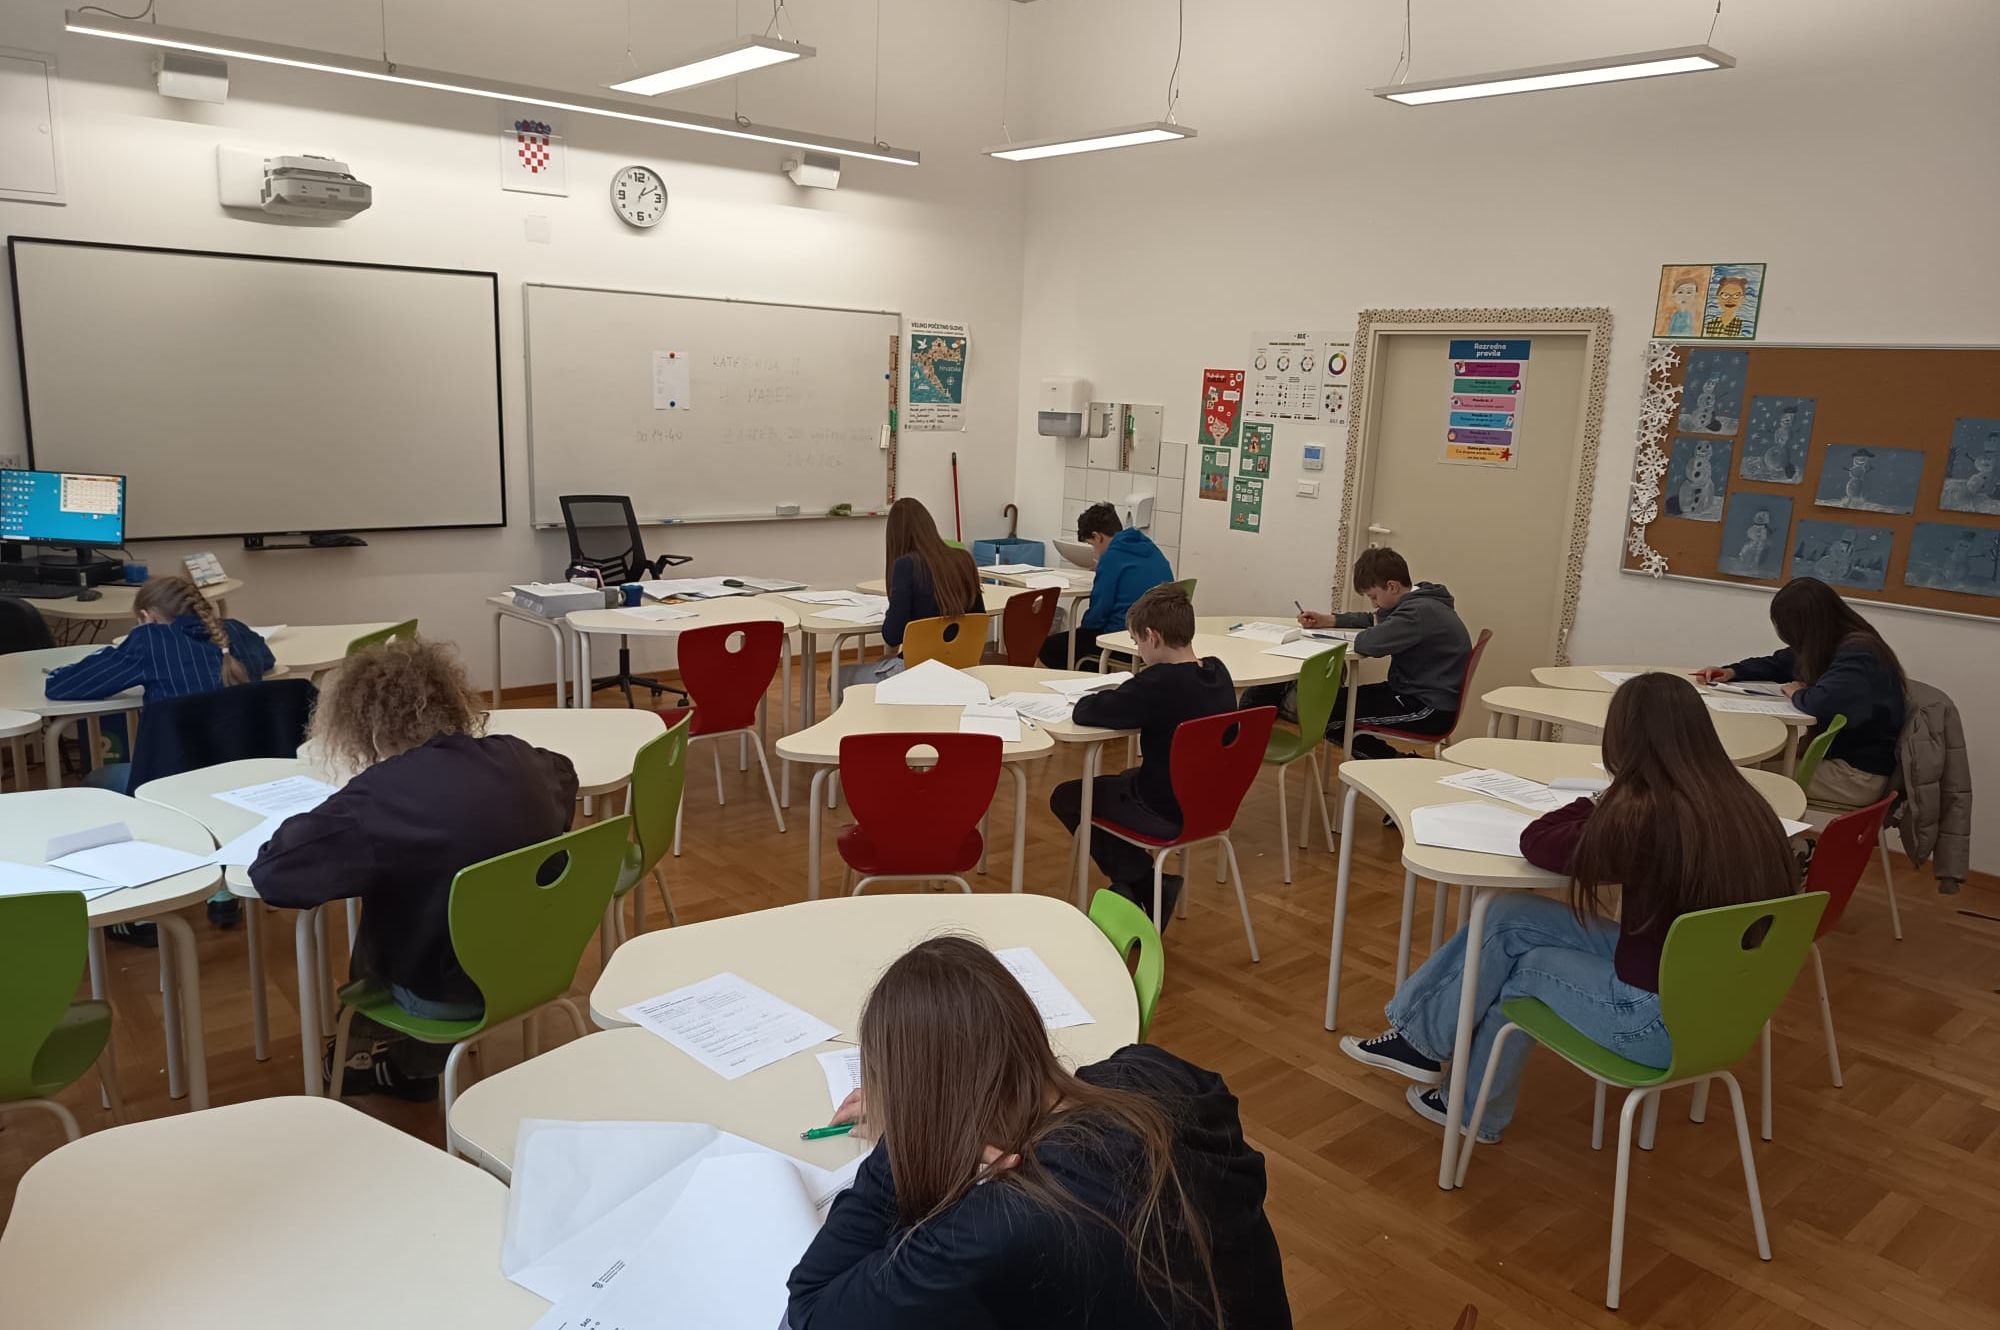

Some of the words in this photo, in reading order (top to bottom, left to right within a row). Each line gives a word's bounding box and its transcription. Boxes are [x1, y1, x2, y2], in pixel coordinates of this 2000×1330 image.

[633, 172, 645, 183] 12
[618, 190, 625, 200] 9
[654, 193, 661, 203] 3
[637, 211, 644, 221] 6
[1474, 342, 1507, 350] Razredna
[1476, 350, 1501, 358] pravila
